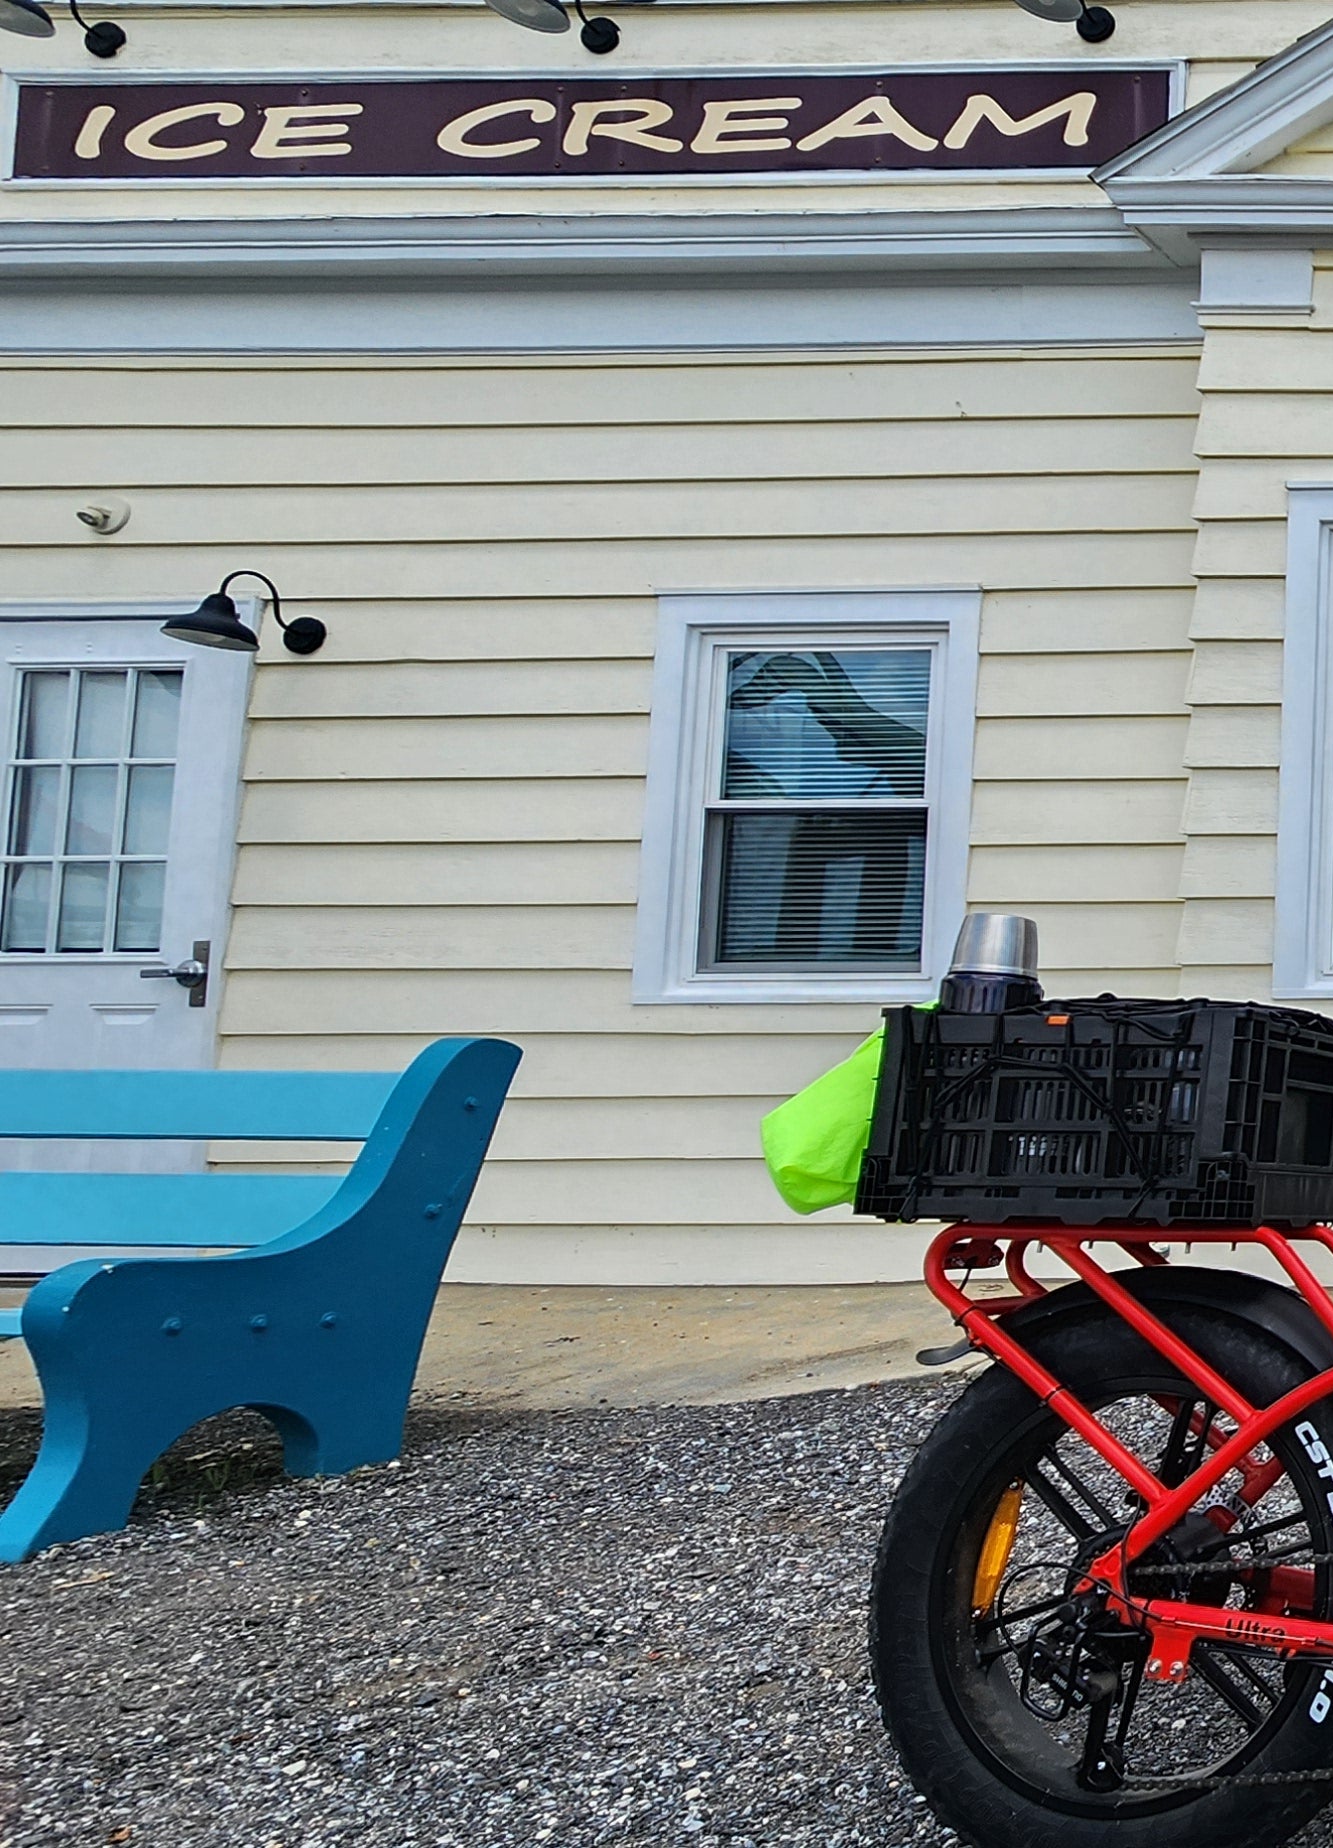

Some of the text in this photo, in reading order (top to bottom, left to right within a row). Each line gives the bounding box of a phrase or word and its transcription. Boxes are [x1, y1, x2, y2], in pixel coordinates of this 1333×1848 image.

[75, 92, 1097, 160] ICE CREAM
[1224, 1618, 1286, 1642] Ultra
